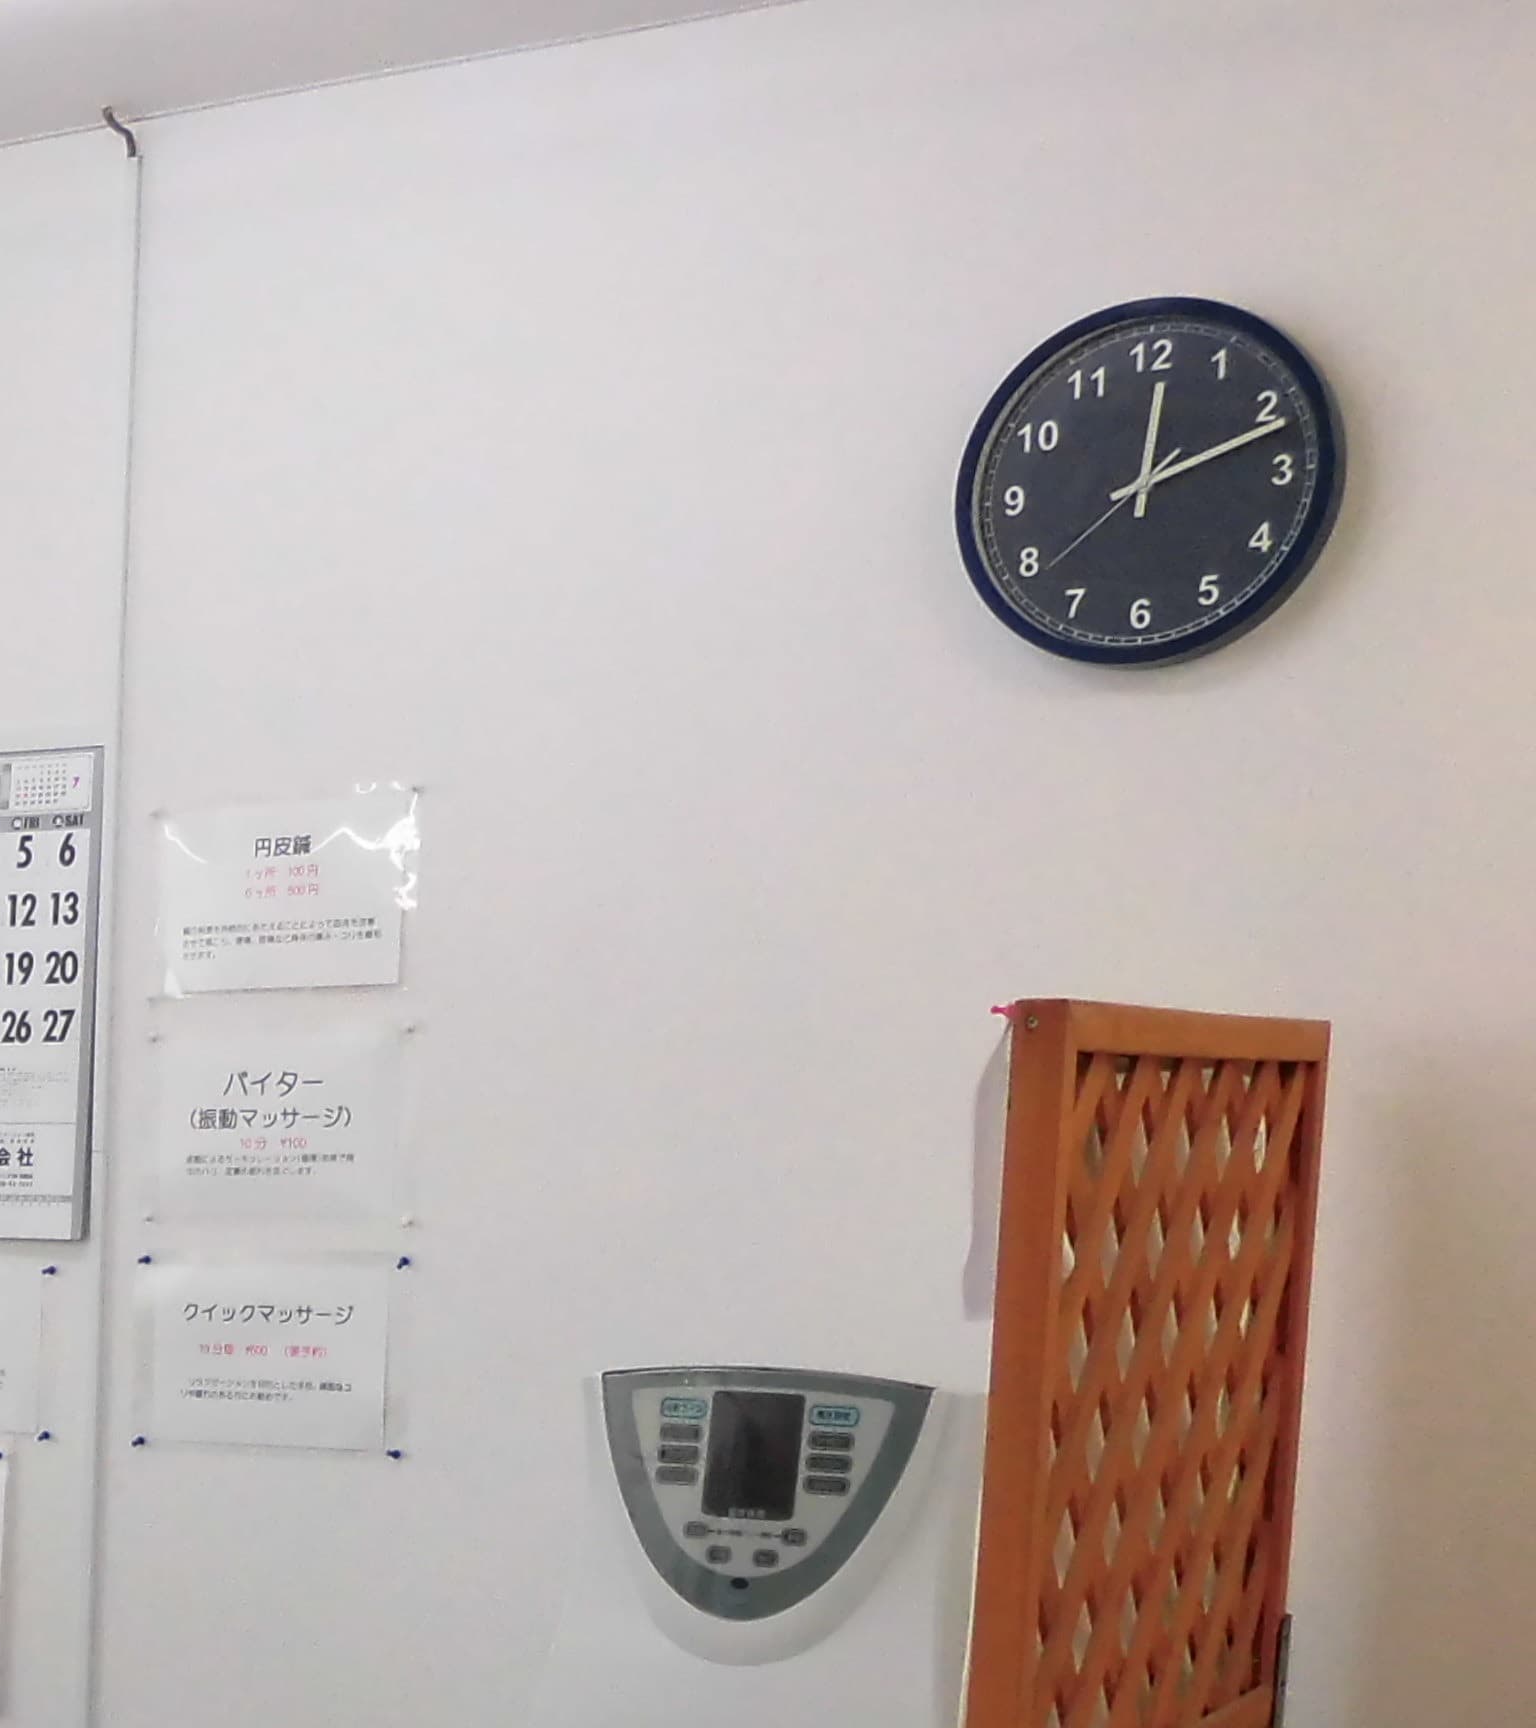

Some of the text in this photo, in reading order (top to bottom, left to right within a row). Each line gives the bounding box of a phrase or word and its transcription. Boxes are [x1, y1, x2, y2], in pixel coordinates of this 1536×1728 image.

[1129, 339, 1173, 372] 12
[1210, 349, 1228, 379] 1
[1067, 366, 1107, 400] 11
[1255, 390, 1279, 423] 2
[1017, 420, 1059, 453] 10
[1271, 454, 1293, 486] 3
[1003, 486, 1025, 516] 9
[1248, 522, 1272, 552] 4
[1019, 548, 1039, 578] 8
[1064, 588, 1086, 619] 7
[1197, 575, 1219, 606] 5
[1129, 599, 1151, 629] 6
[17, 835, 33, 869] 5
[59, 832, 76, 867] 6
[8, 893, 37, 927] 12
[51, 891, 79, 925] 13
[5, 952, 34, 985] 19
[45, 951, 78, 984] 20
[1, 1010, 32, 1044] 26
[42, 1009, 75, 1043] 27
[189, 1105, 353, 1130] (振動マッサージ)
[183, 1302, 354, 1326] クイックマッサージ
